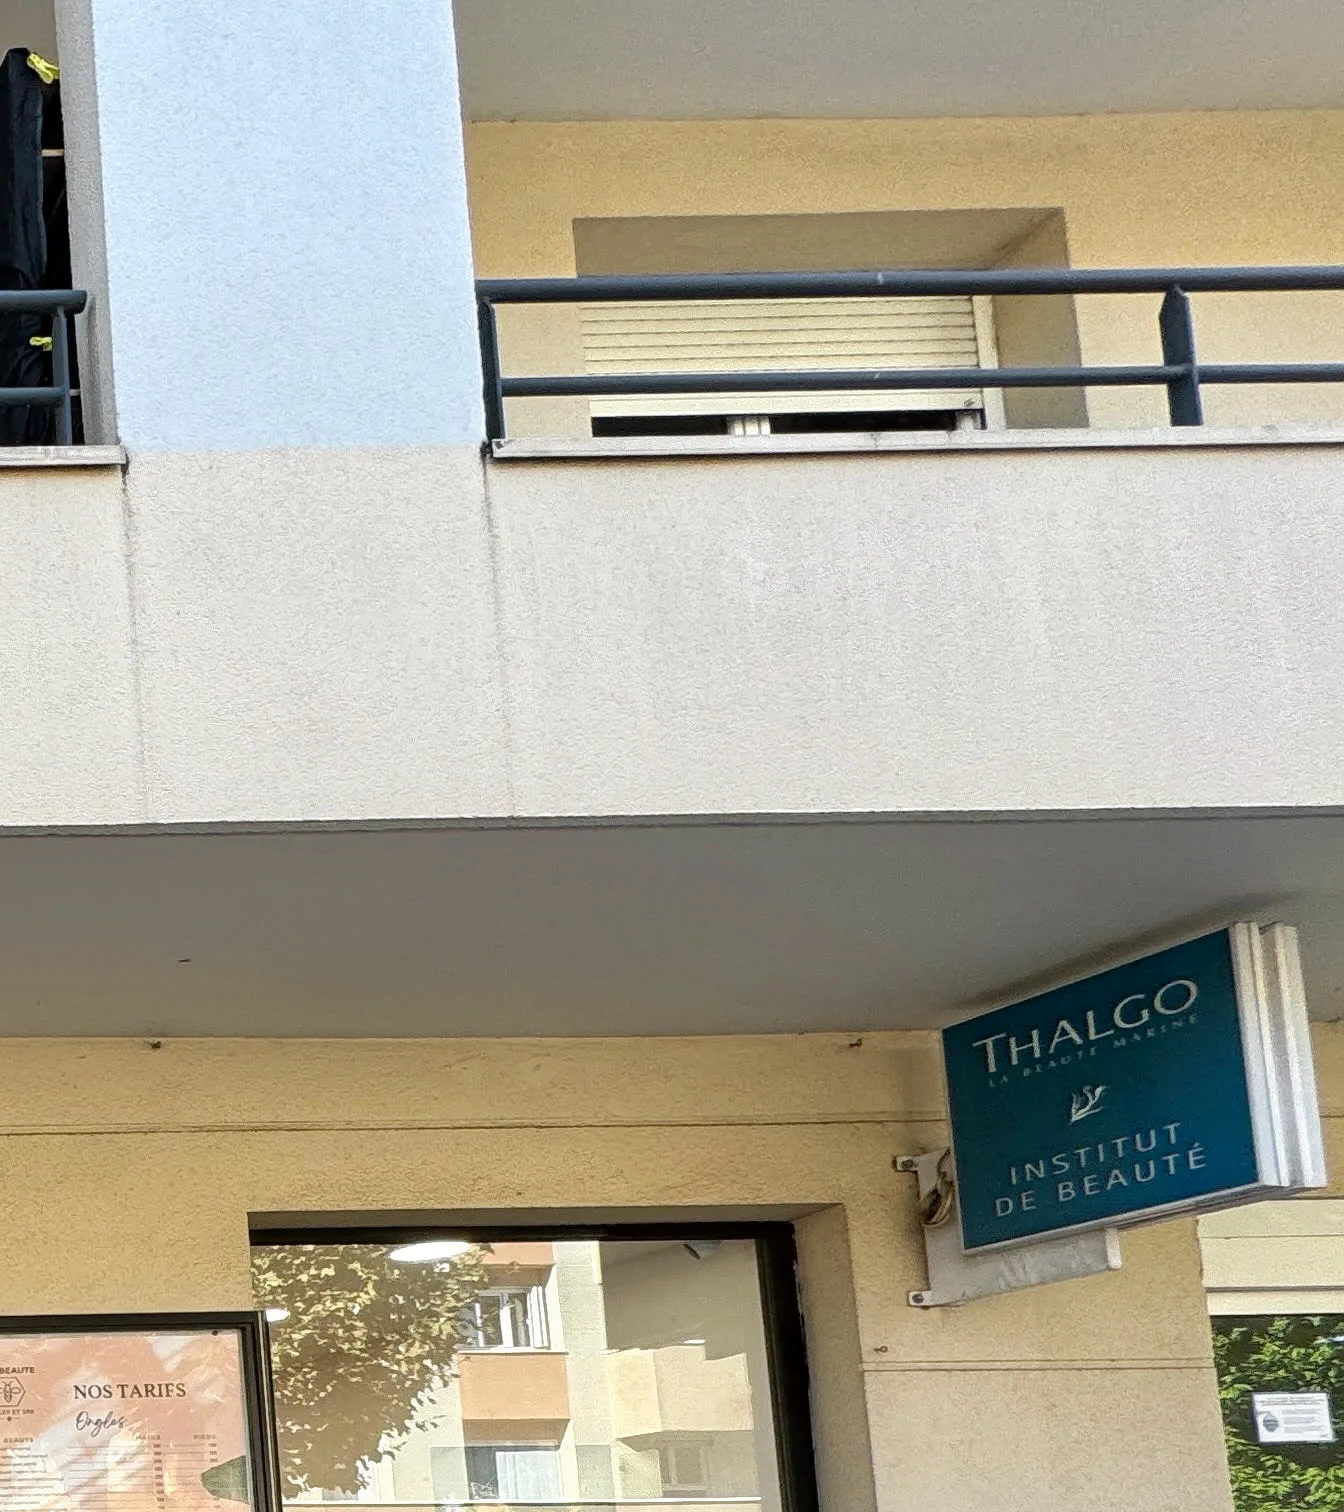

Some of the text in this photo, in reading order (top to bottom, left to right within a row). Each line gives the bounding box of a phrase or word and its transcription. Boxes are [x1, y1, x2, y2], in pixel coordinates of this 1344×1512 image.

[973, 979, 1199, 1073] THALGO
[1112, 1013, 1198, 1049] MARINE
[1009, 1121, 1182, 1185] INSTITUT
[995, 1141, 1208, 1219] DE BEAUTÉ
[73, 1382, 188, 1400] NOS TARIFS
[75, 1410, 127, 1438] Ongles
